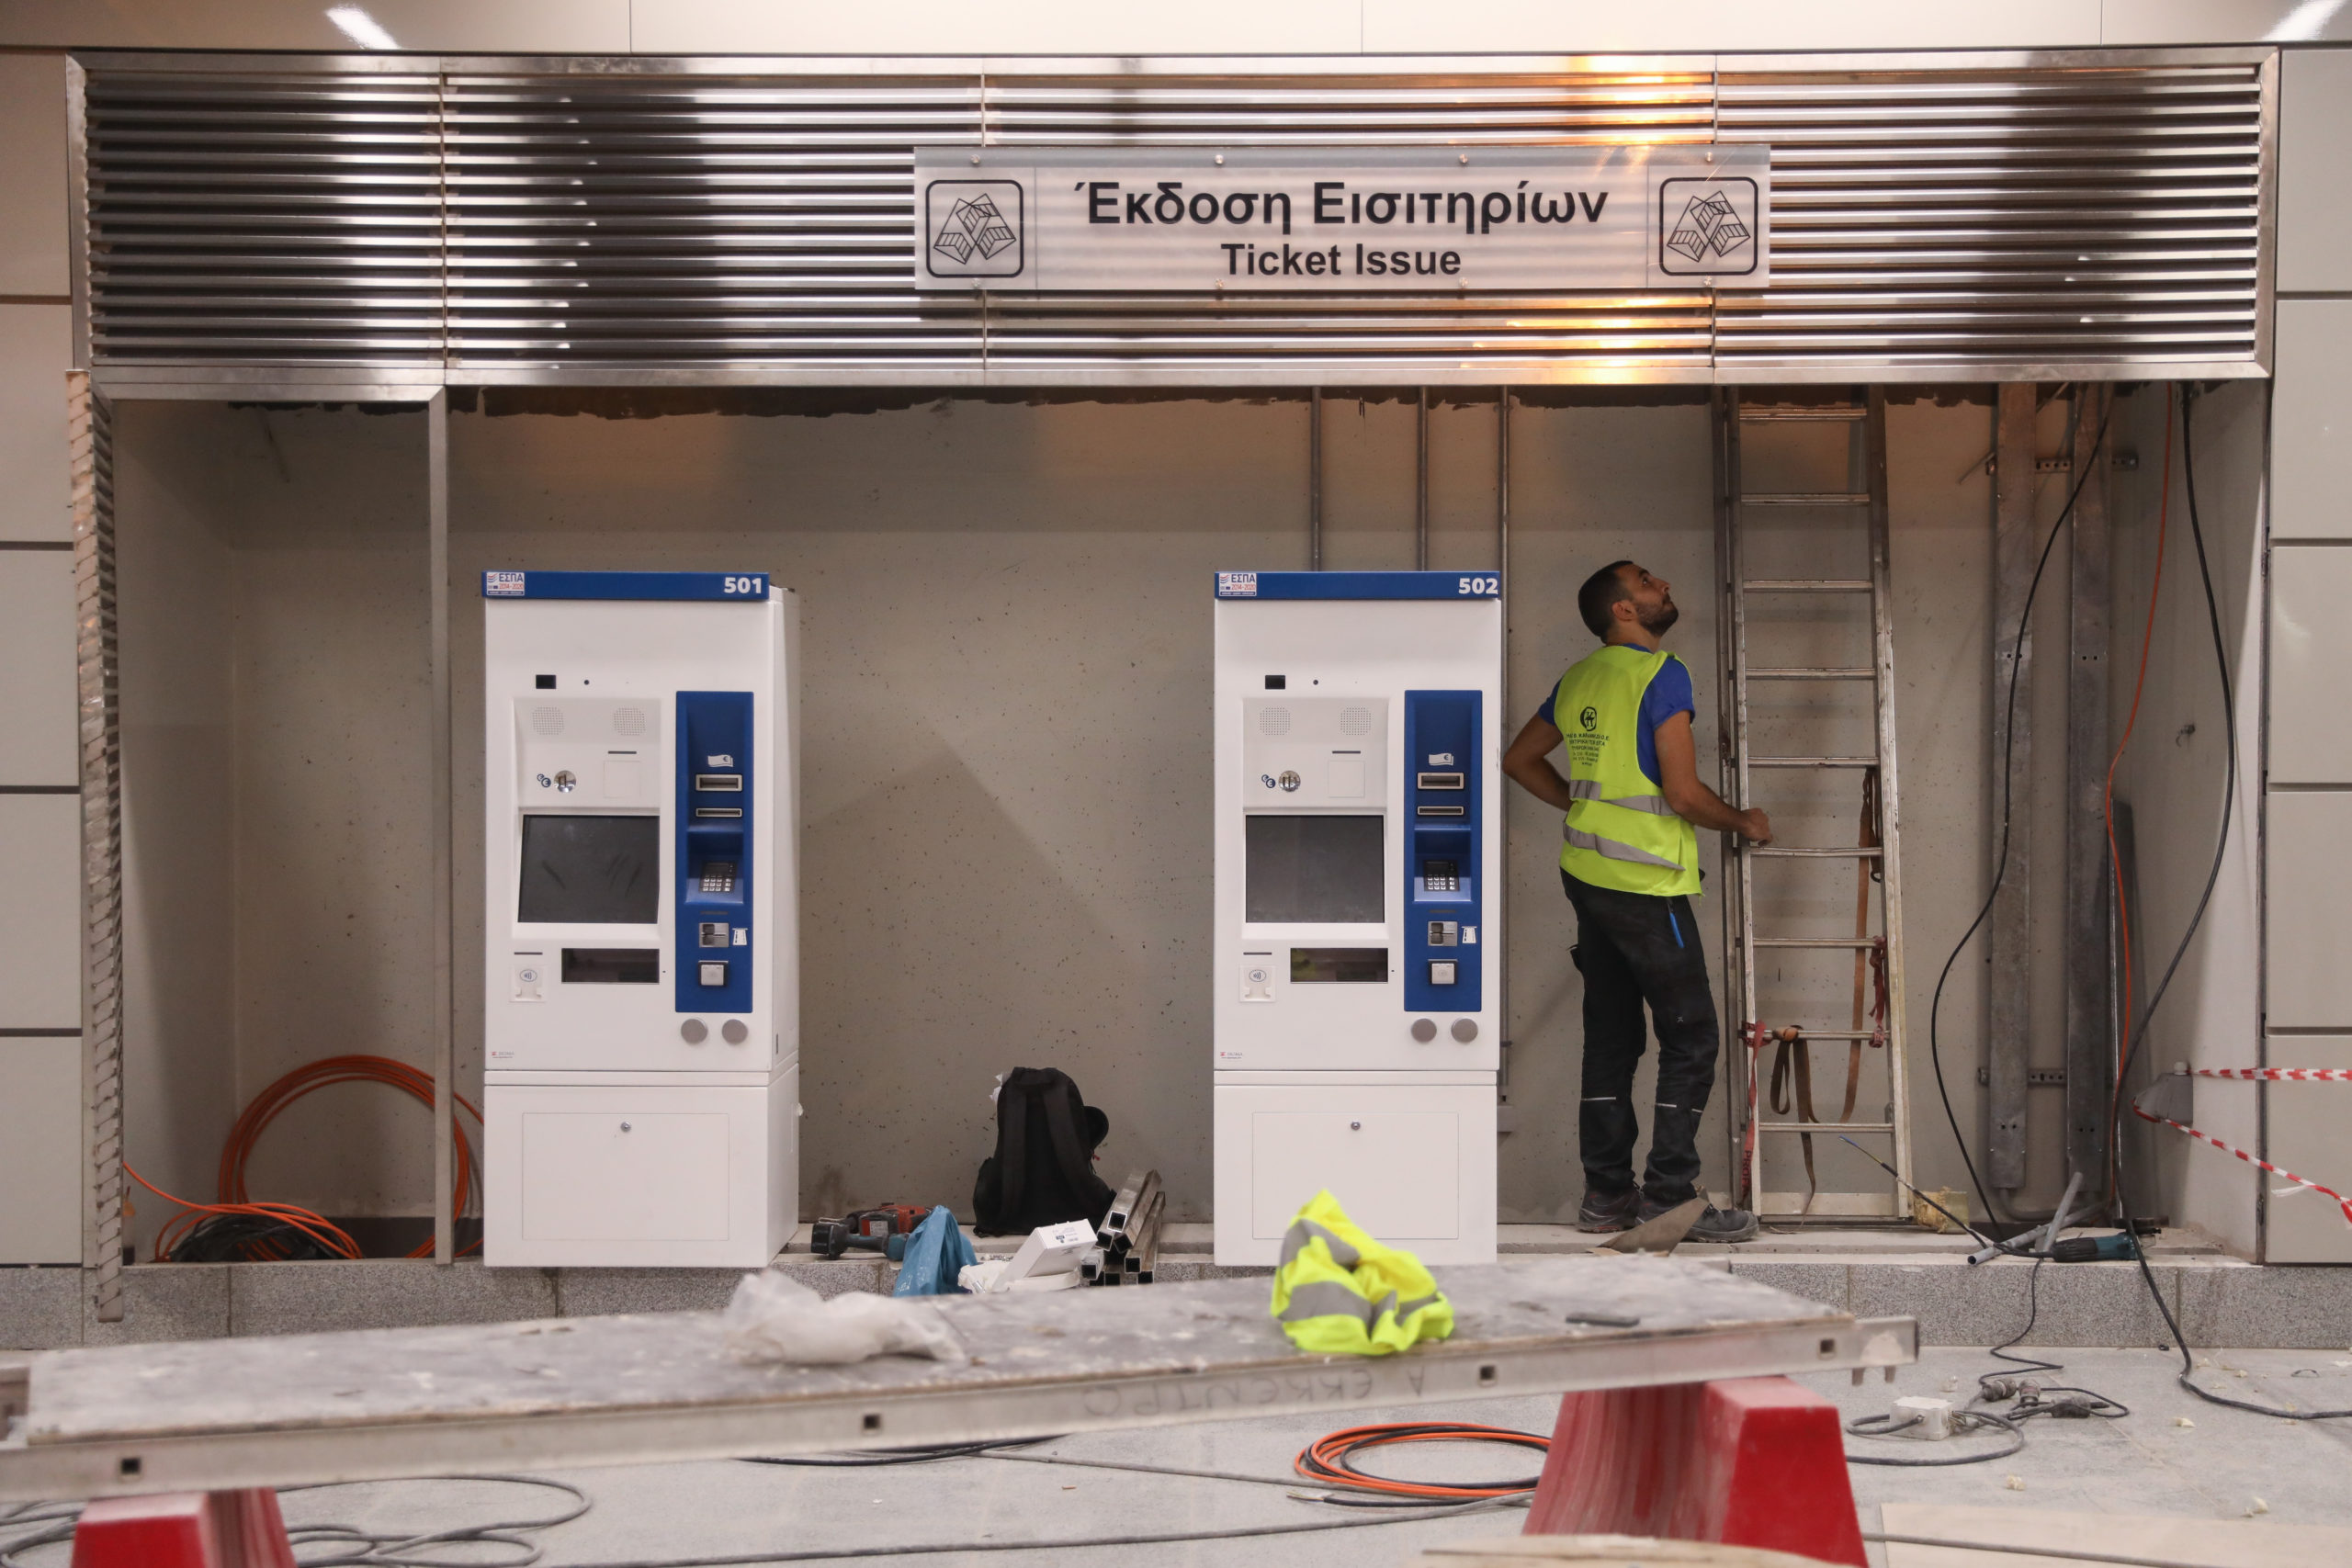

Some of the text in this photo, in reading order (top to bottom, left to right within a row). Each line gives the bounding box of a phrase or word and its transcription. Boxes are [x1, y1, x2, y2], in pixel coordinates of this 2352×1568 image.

[1075, 180, 1608, 235] Έκδοση Εισιτηρίων
[1220, 243, 1461, 276] Ticket Issue
[499, 573, 524, 582] ΕΣΠΑ
[723, 577, 762, 594] 501
[1231, 573, 1256, 582] ΕΣΠΑ
[1458, 577, 1498, 595] 502
